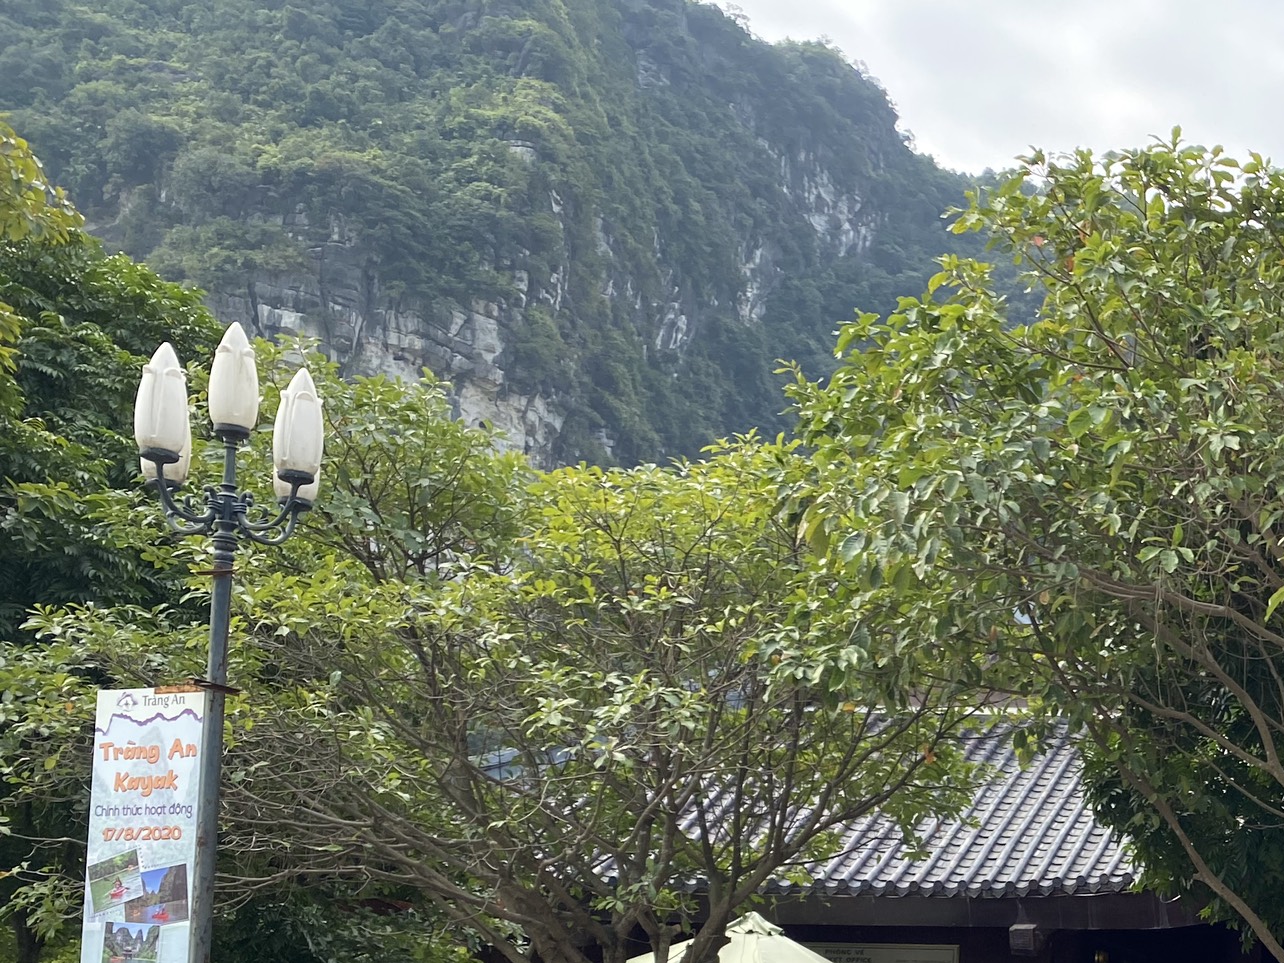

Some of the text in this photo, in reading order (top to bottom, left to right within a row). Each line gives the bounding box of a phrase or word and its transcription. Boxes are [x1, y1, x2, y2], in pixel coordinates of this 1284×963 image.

[142, 694, 186, 707] Tràng An
[99, 738, 198, 765] Tràng An
[114, 770, 179, 797] Kayak
[94, 802, 193, 818] Chính thức hoạt động
[102, 825, 182, 842] 17/8/2020
